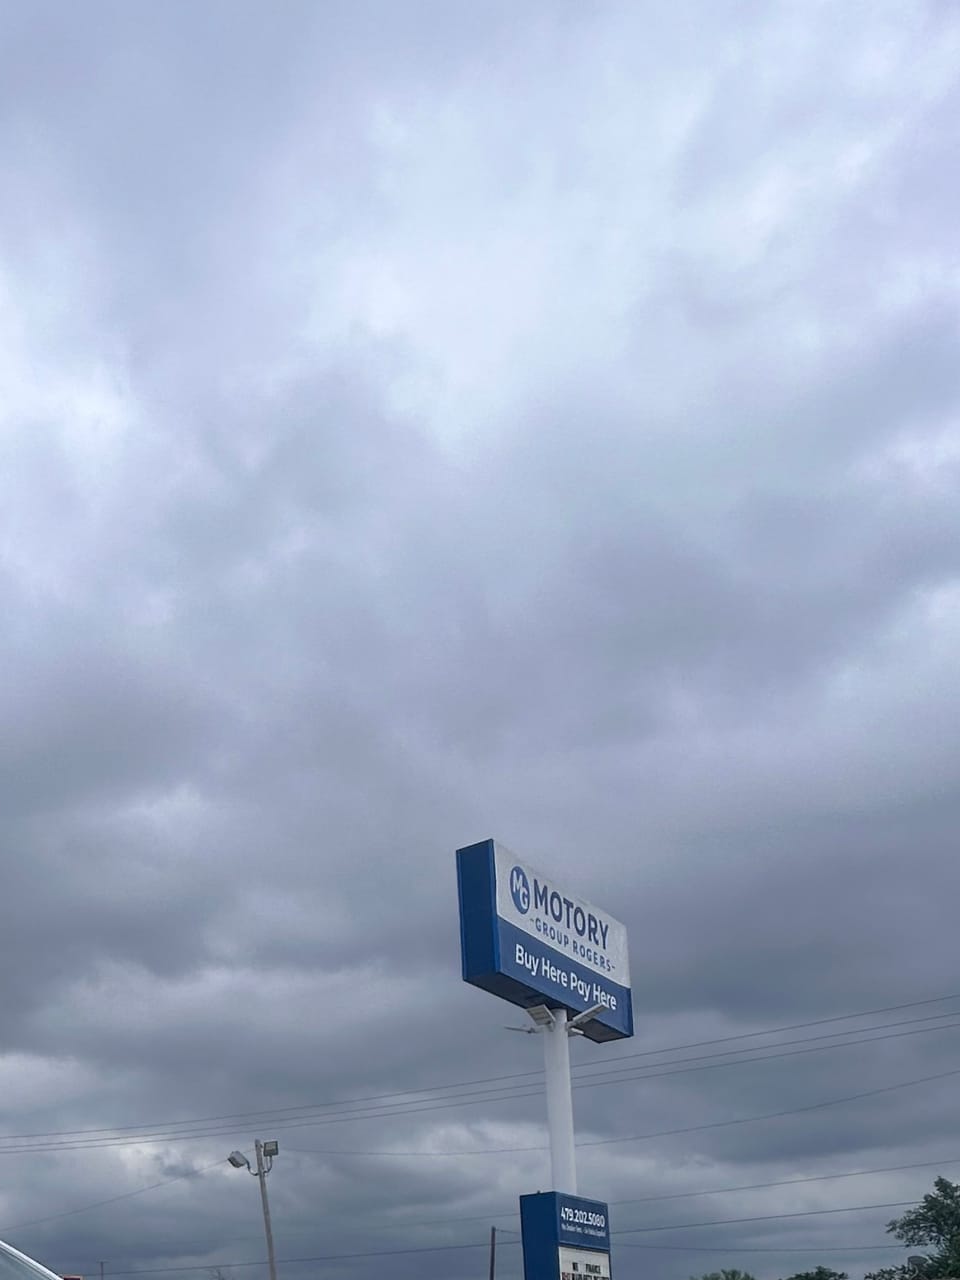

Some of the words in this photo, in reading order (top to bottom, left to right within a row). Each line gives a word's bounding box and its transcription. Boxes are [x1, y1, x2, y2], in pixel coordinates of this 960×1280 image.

[533, 878, 609, 950] MOTORY
[515, 943, 539, 976] Buy
[541, 959, 568, 987] Here
[570, 972, 591, 1002] Pay
[592, 983, 617, 1010] Here
